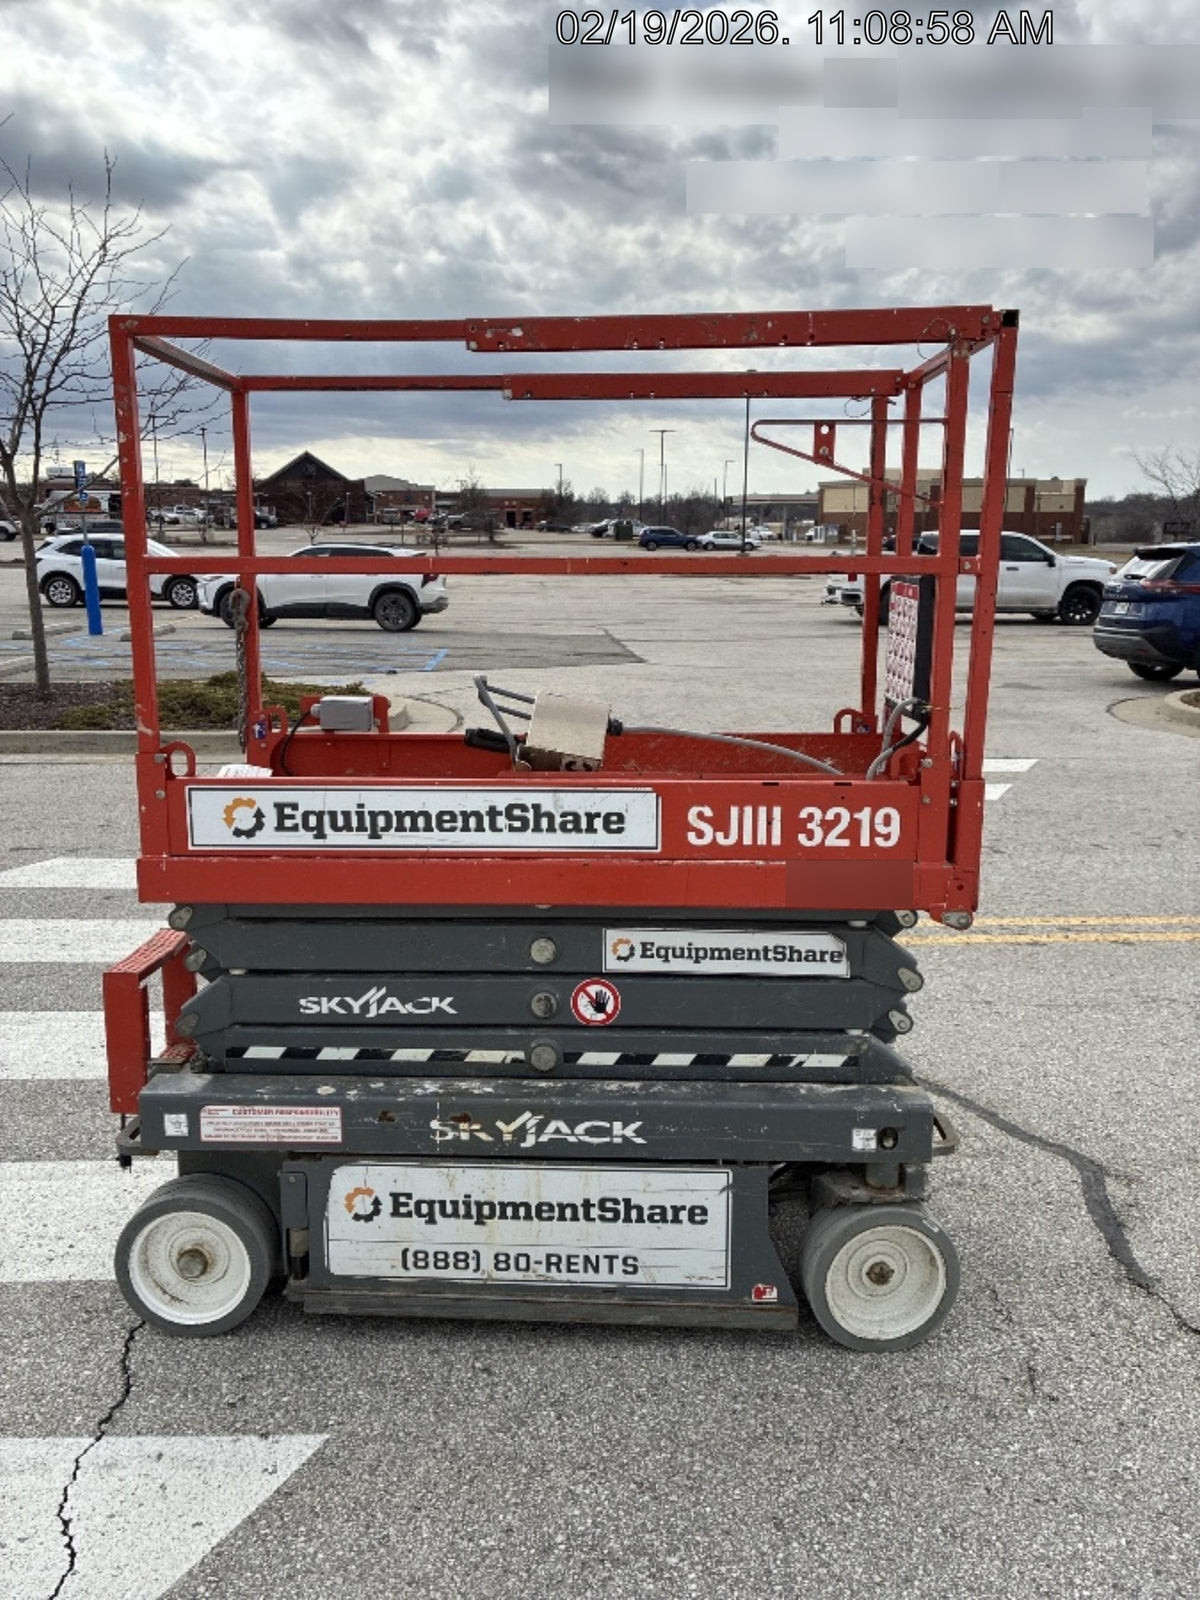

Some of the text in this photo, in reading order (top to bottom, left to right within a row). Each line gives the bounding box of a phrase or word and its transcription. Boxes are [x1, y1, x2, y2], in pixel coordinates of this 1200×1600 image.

[273, 802, 626, 840] EquipmentShare
[797, 806, 901, 848] 3219
[639, 941, 844, 964] EquipmentShare
[298, 986, 457, 1018] SKYJACK
[429, 1110, 648, 1148] SKYJACK
[389, 1192, 708, 1226] EquipmentShare
[401, 1248, 640, 1276] (888) 80-RENTS
